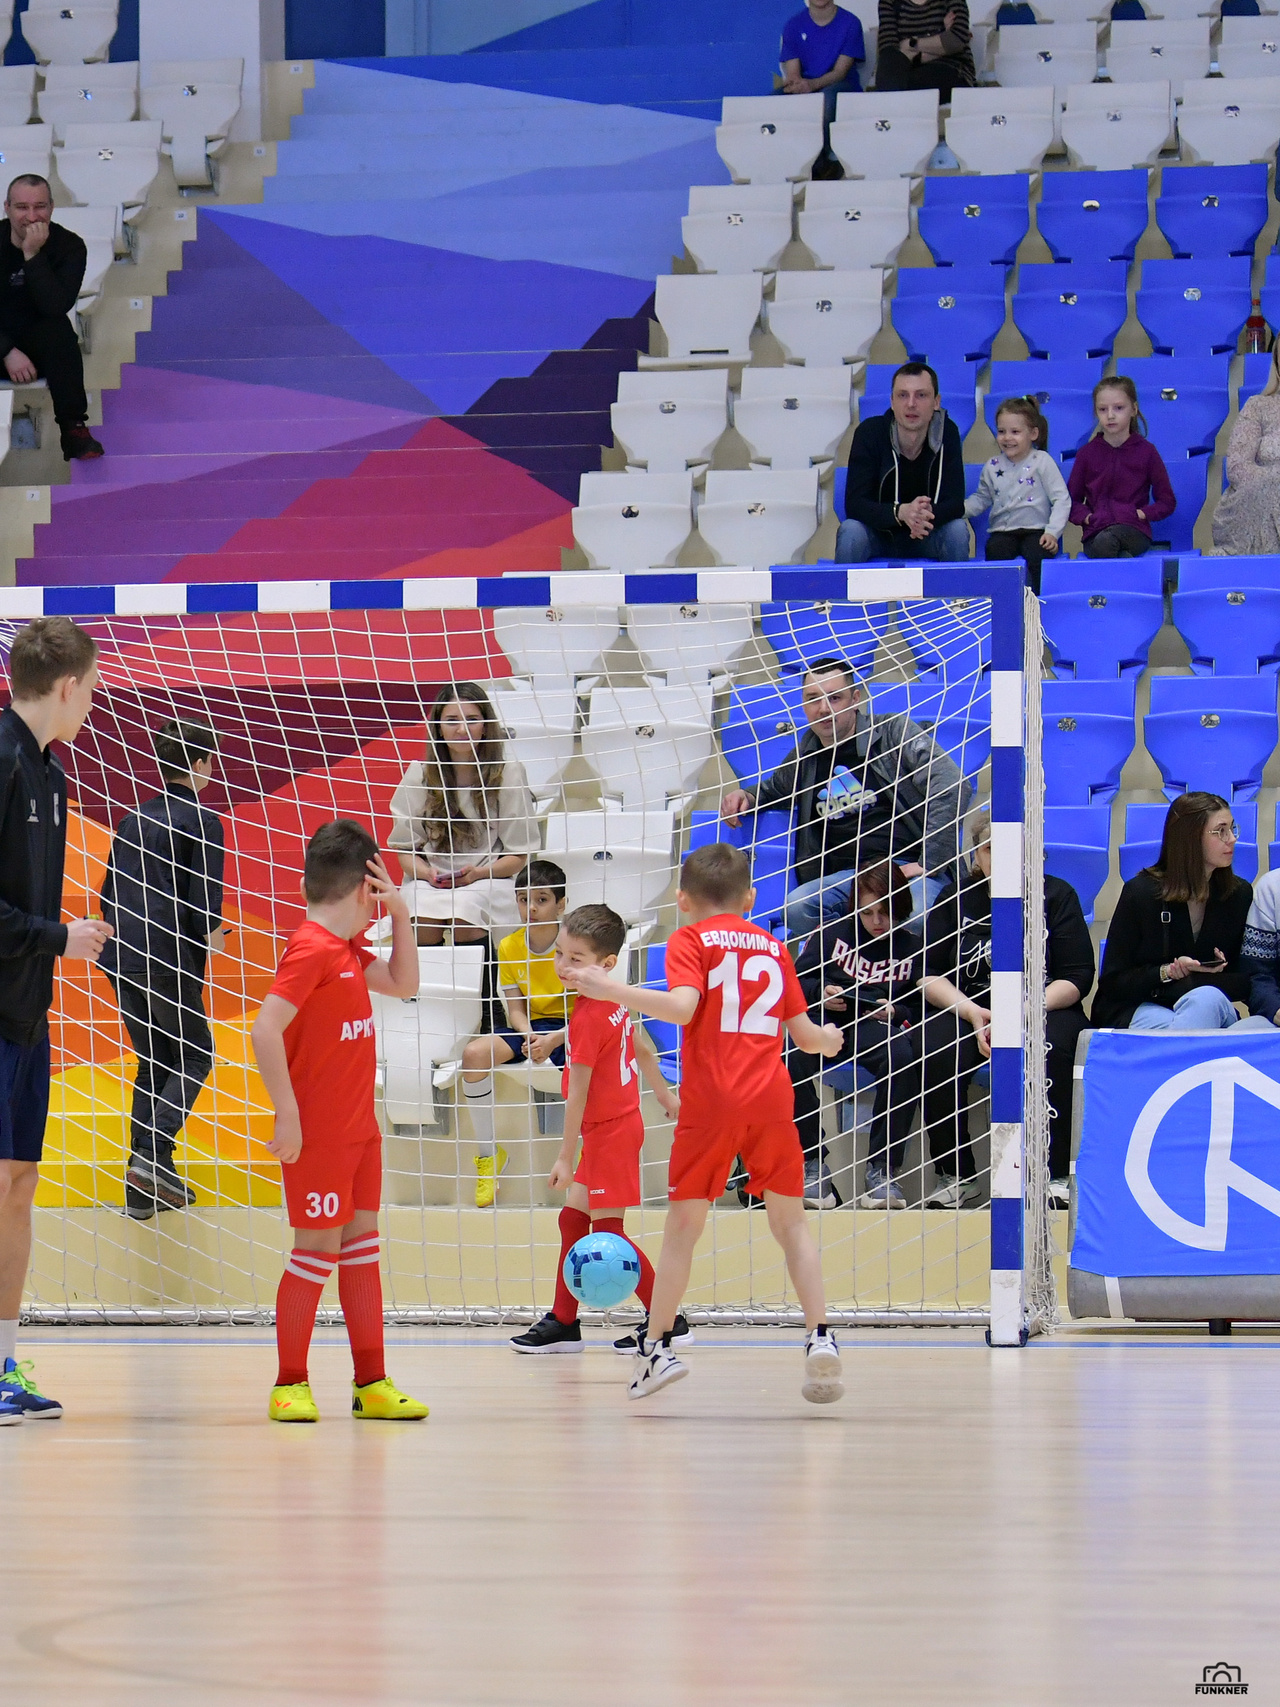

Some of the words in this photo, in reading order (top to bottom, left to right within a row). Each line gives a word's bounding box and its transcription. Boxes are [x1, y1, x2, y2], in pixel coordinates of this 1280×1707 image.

[700, 930, 781, 957] ЕВДОКИМВ
[831, 937, 914, 985] RUSSIA
[707, 951, 784, 1037] 12
[305, 1191, 339, 1219] 30
